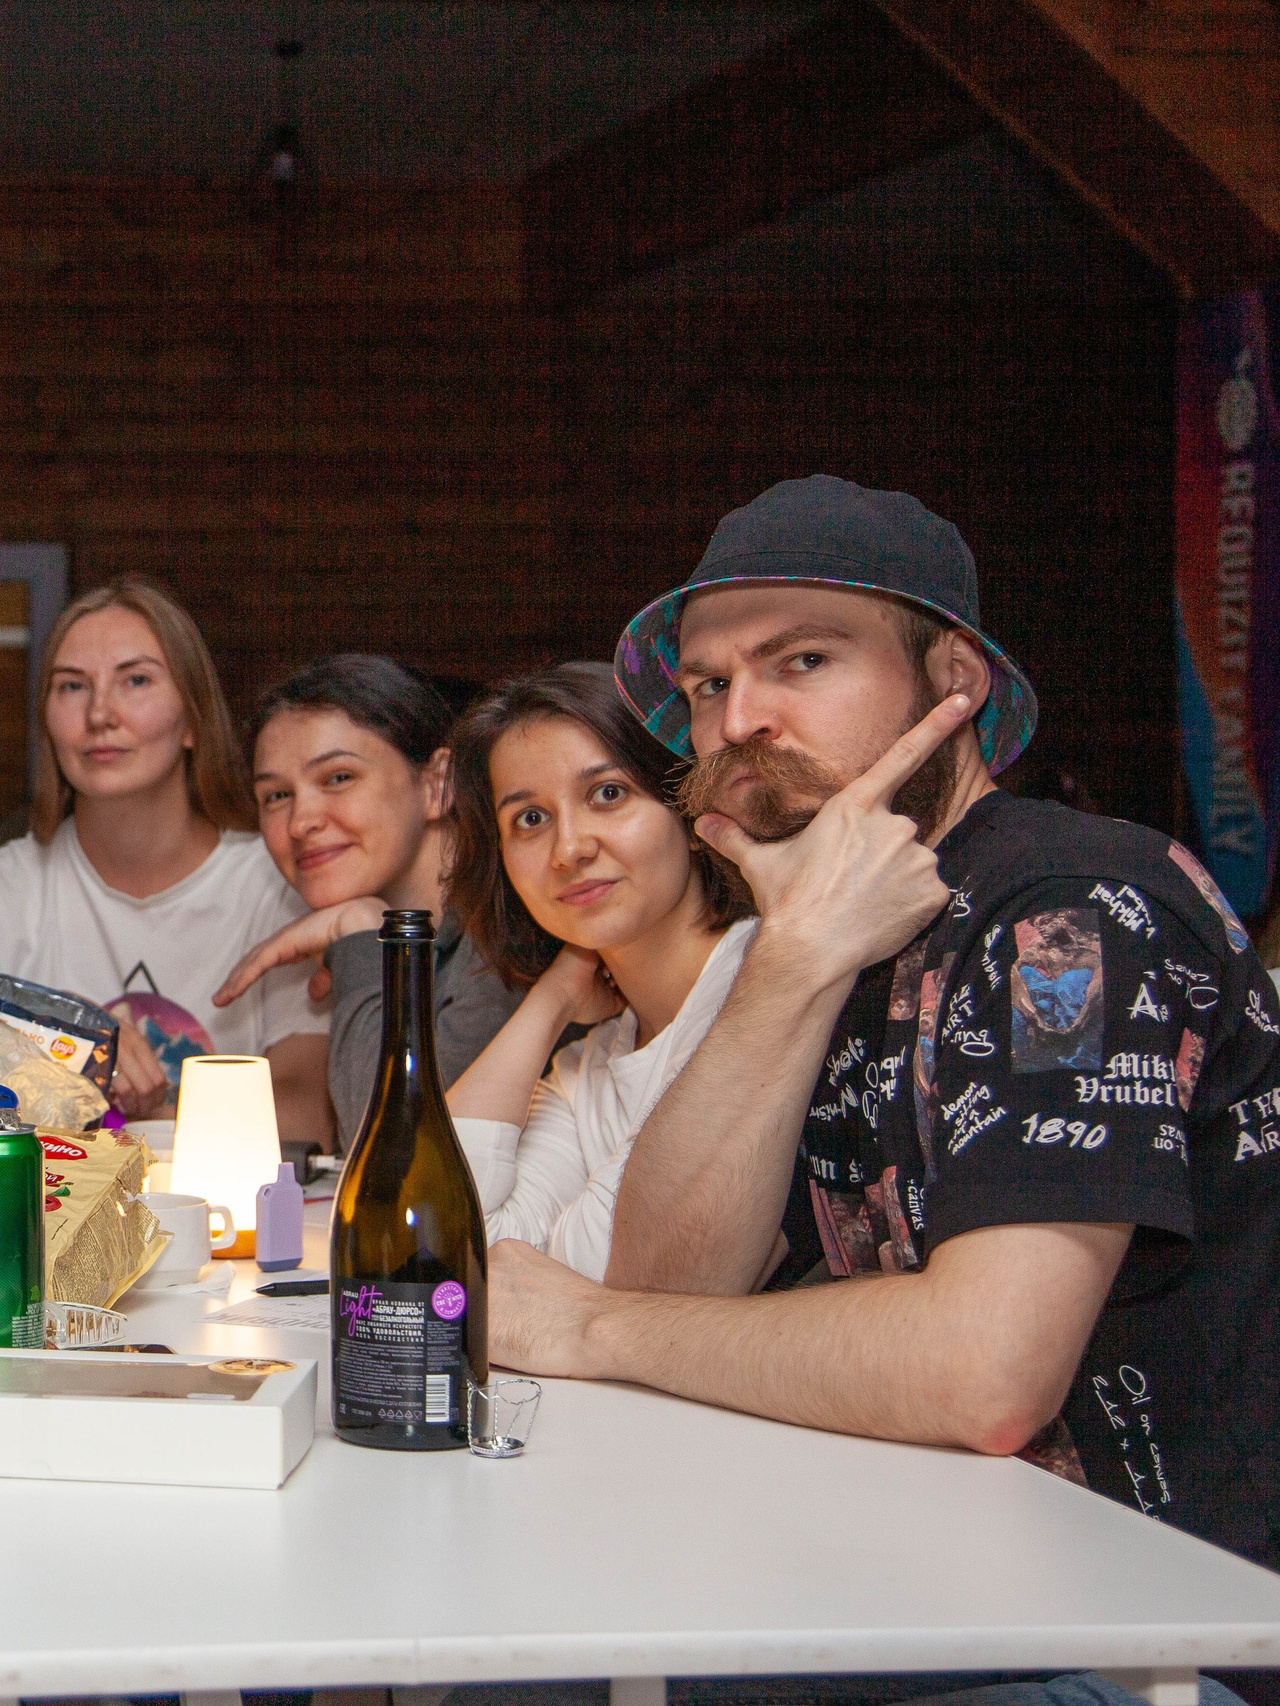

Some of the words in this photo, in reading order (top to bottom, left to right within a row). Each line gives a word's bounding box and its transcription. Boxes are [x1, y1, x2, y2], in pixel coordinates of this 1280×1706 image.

[1074, 1076, 1177, 1107] Vrubel
[952, 1106, 1007, 1156] mountain
[1021, 1113, 1109, 1149] 1890
[339, 1284, 384, 1337] Light
